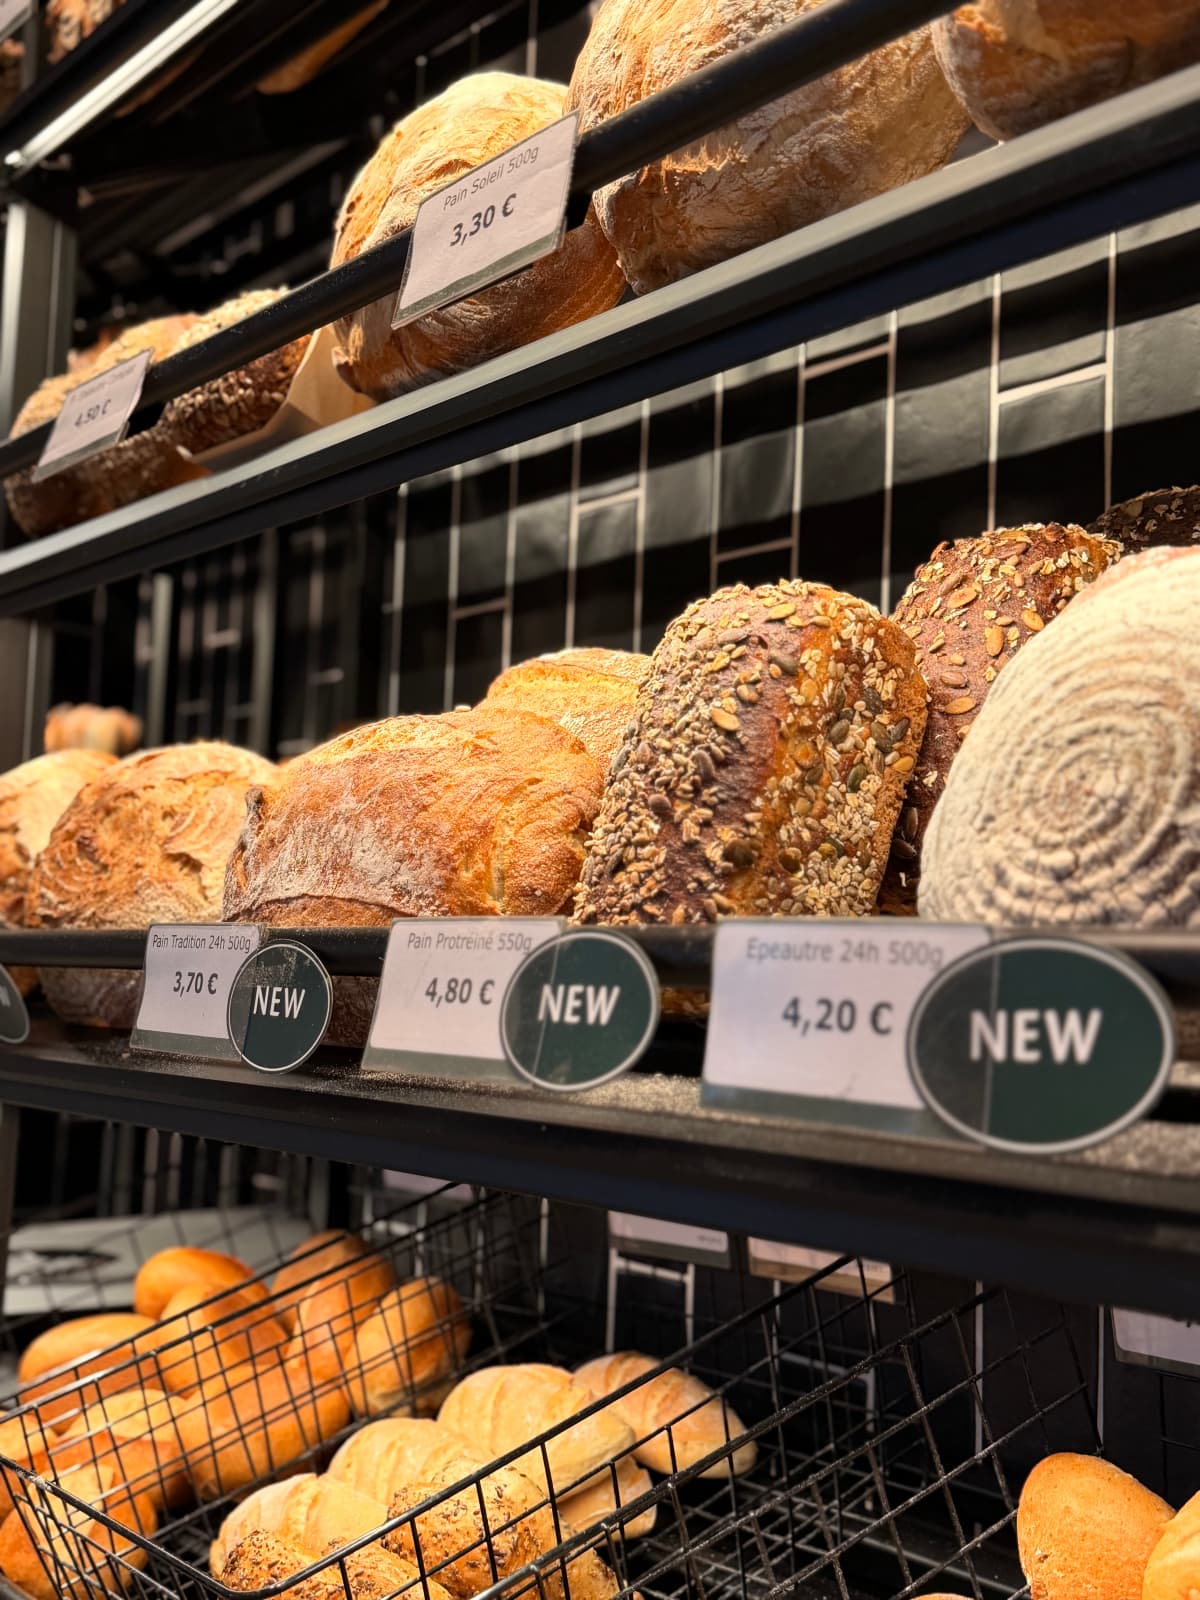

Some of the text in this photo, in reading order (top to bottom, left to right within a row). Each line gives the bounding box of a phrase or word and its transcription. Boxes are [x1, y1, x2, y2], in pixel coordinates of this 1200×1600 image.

[443, 147, 539, 211] Pain Soleil 500g
[450, 193, 517, 247] 3,30 €
[152, 934, 251, 954] Pain Tradition 24h 500g
[407, 932, 432, 949] Pain
[497, 933, 533, 955] 550g
[745, 937, 945, 970] Epeautre 24h 500g
[173, 971, 218, 997] 3,70 €
[424, 977, 495, 1008] 4,80 €
[253, 985, 306, 1020] NEW
[538, 984, 620, 1027] NEW
[781, 997, 893, 1036] 4,20 €
[970, 1009, 1101, 1064] NEW
